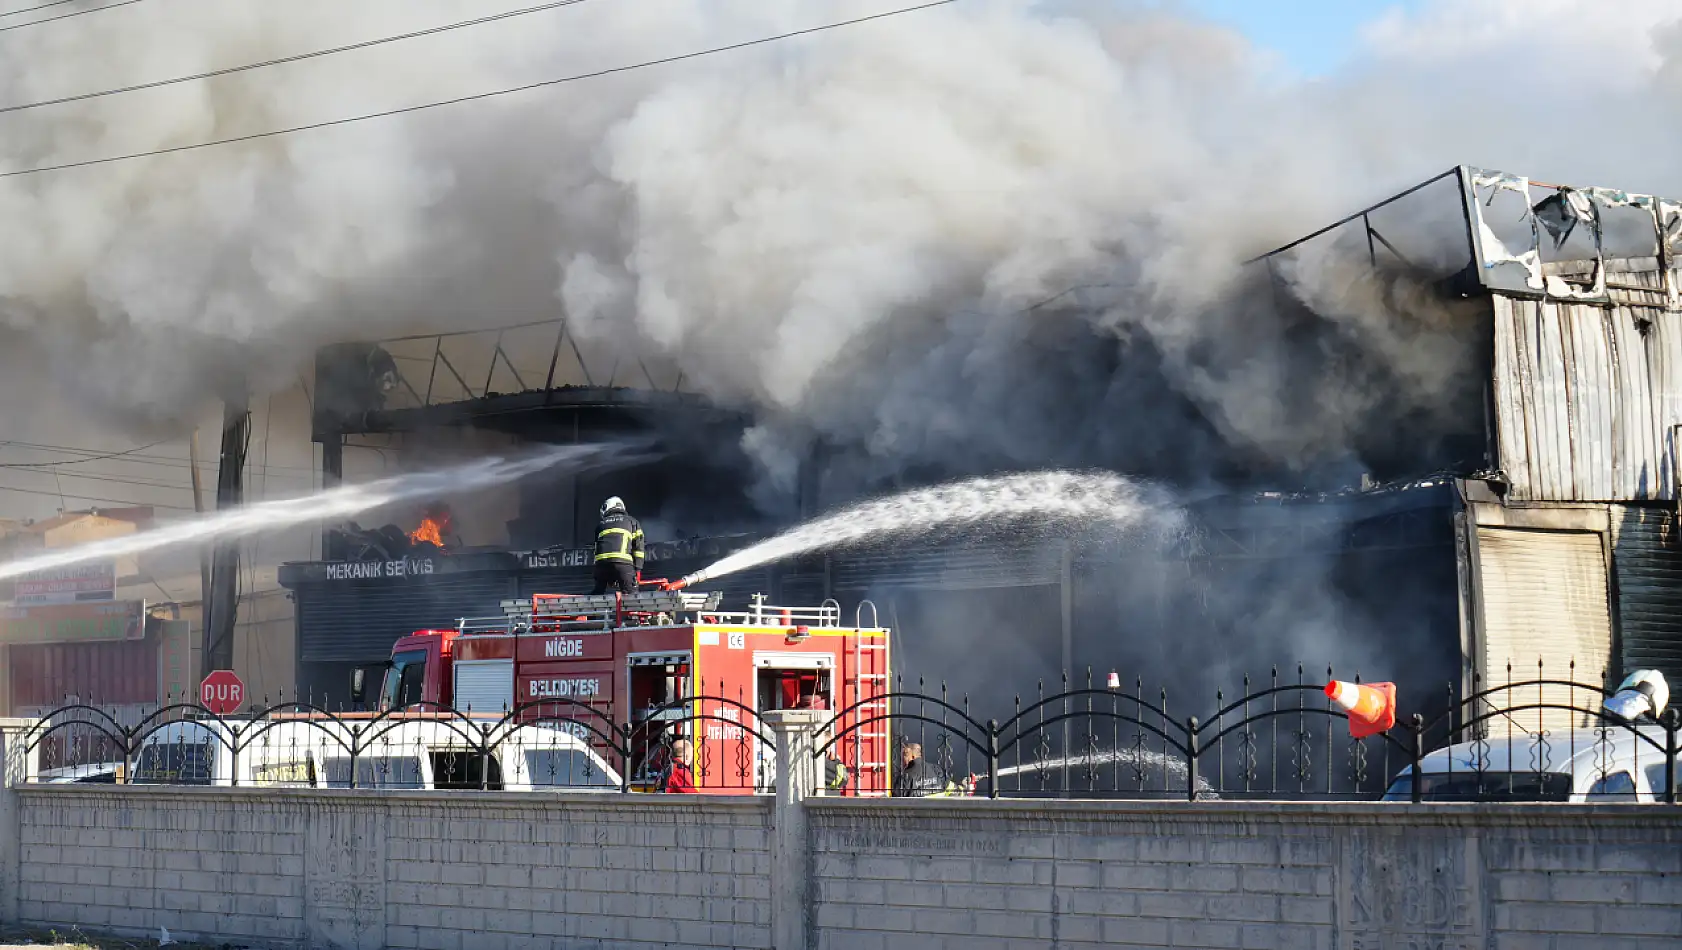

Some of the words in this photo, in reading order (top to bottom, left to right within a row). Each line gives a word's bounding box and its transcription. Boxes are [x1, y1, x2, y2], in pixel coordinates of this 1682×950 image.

[326, 561, 382, 579] MEKANİK
[545, 636, 583, 657] NİĞDE
[205, 684, 240, 701] DUR
[530, 679, 599, 696] BELEDİYESİ
